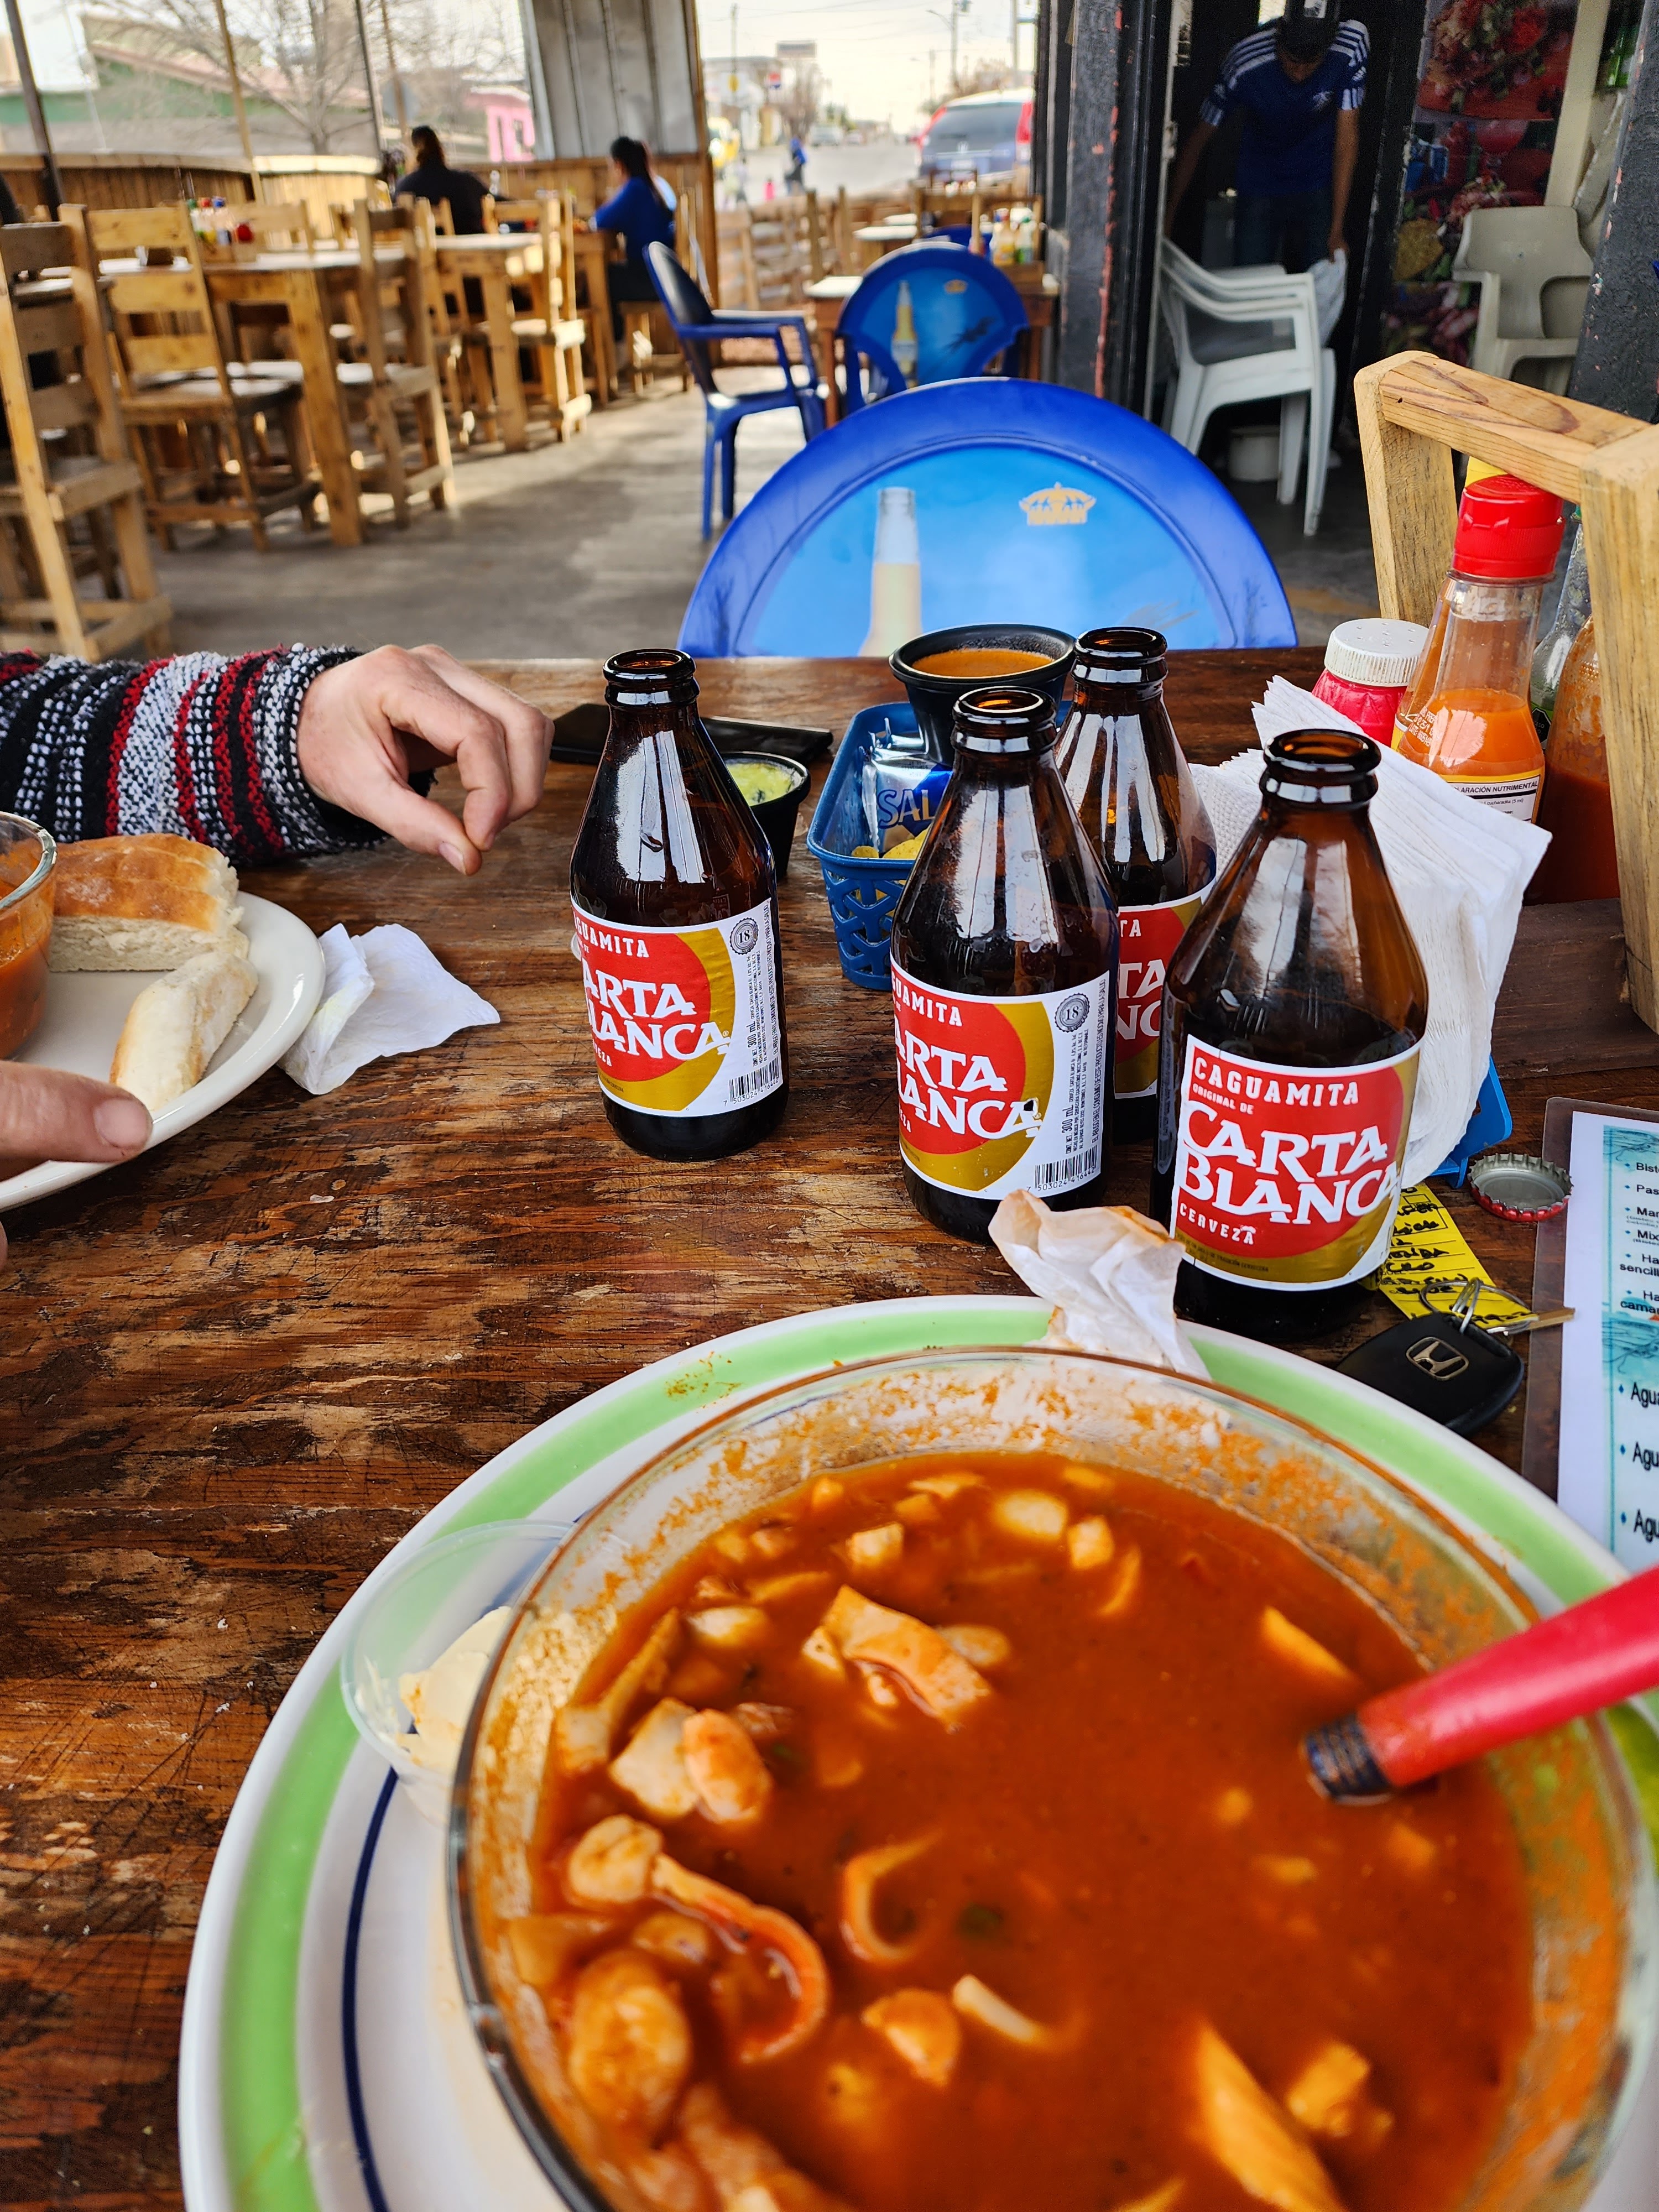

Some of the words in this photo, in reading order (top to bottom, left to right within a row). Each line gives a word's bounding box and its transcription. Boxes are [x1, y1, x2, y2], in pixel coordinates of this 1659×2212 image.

[1493, 781, 1538, 792] NUTRIMENTAL
[573, 911, 649, 958] GUAMITA
[739, 931, 750, 943] 18
[891, 971, 962, 1027] GUAMITA
[587, 998, 732, 1060] LANCA
[746, 1021, 756, 1033] mL
[747, 1034, 757, 1048] 300
[1194, 1057, 1359, 1107] CAGUAMITA
[733, 1092, 758, 1104] 503024
[1192, 1084, 1236, 1110] ORIGINAL
[1239, 1104, 1254, 1115] DE
[1062, 1104, 1073, 1118] mL
[1061, 1118, 1073, 1133] 300
[1181, 1100, 1387, 1183] CARTA
[1038, 1181, 1067, 1191] 503024
[1178, 1150, 1401, 1224] BLANCA
[1180, 1203, 1254, 1245] CERVEZA
